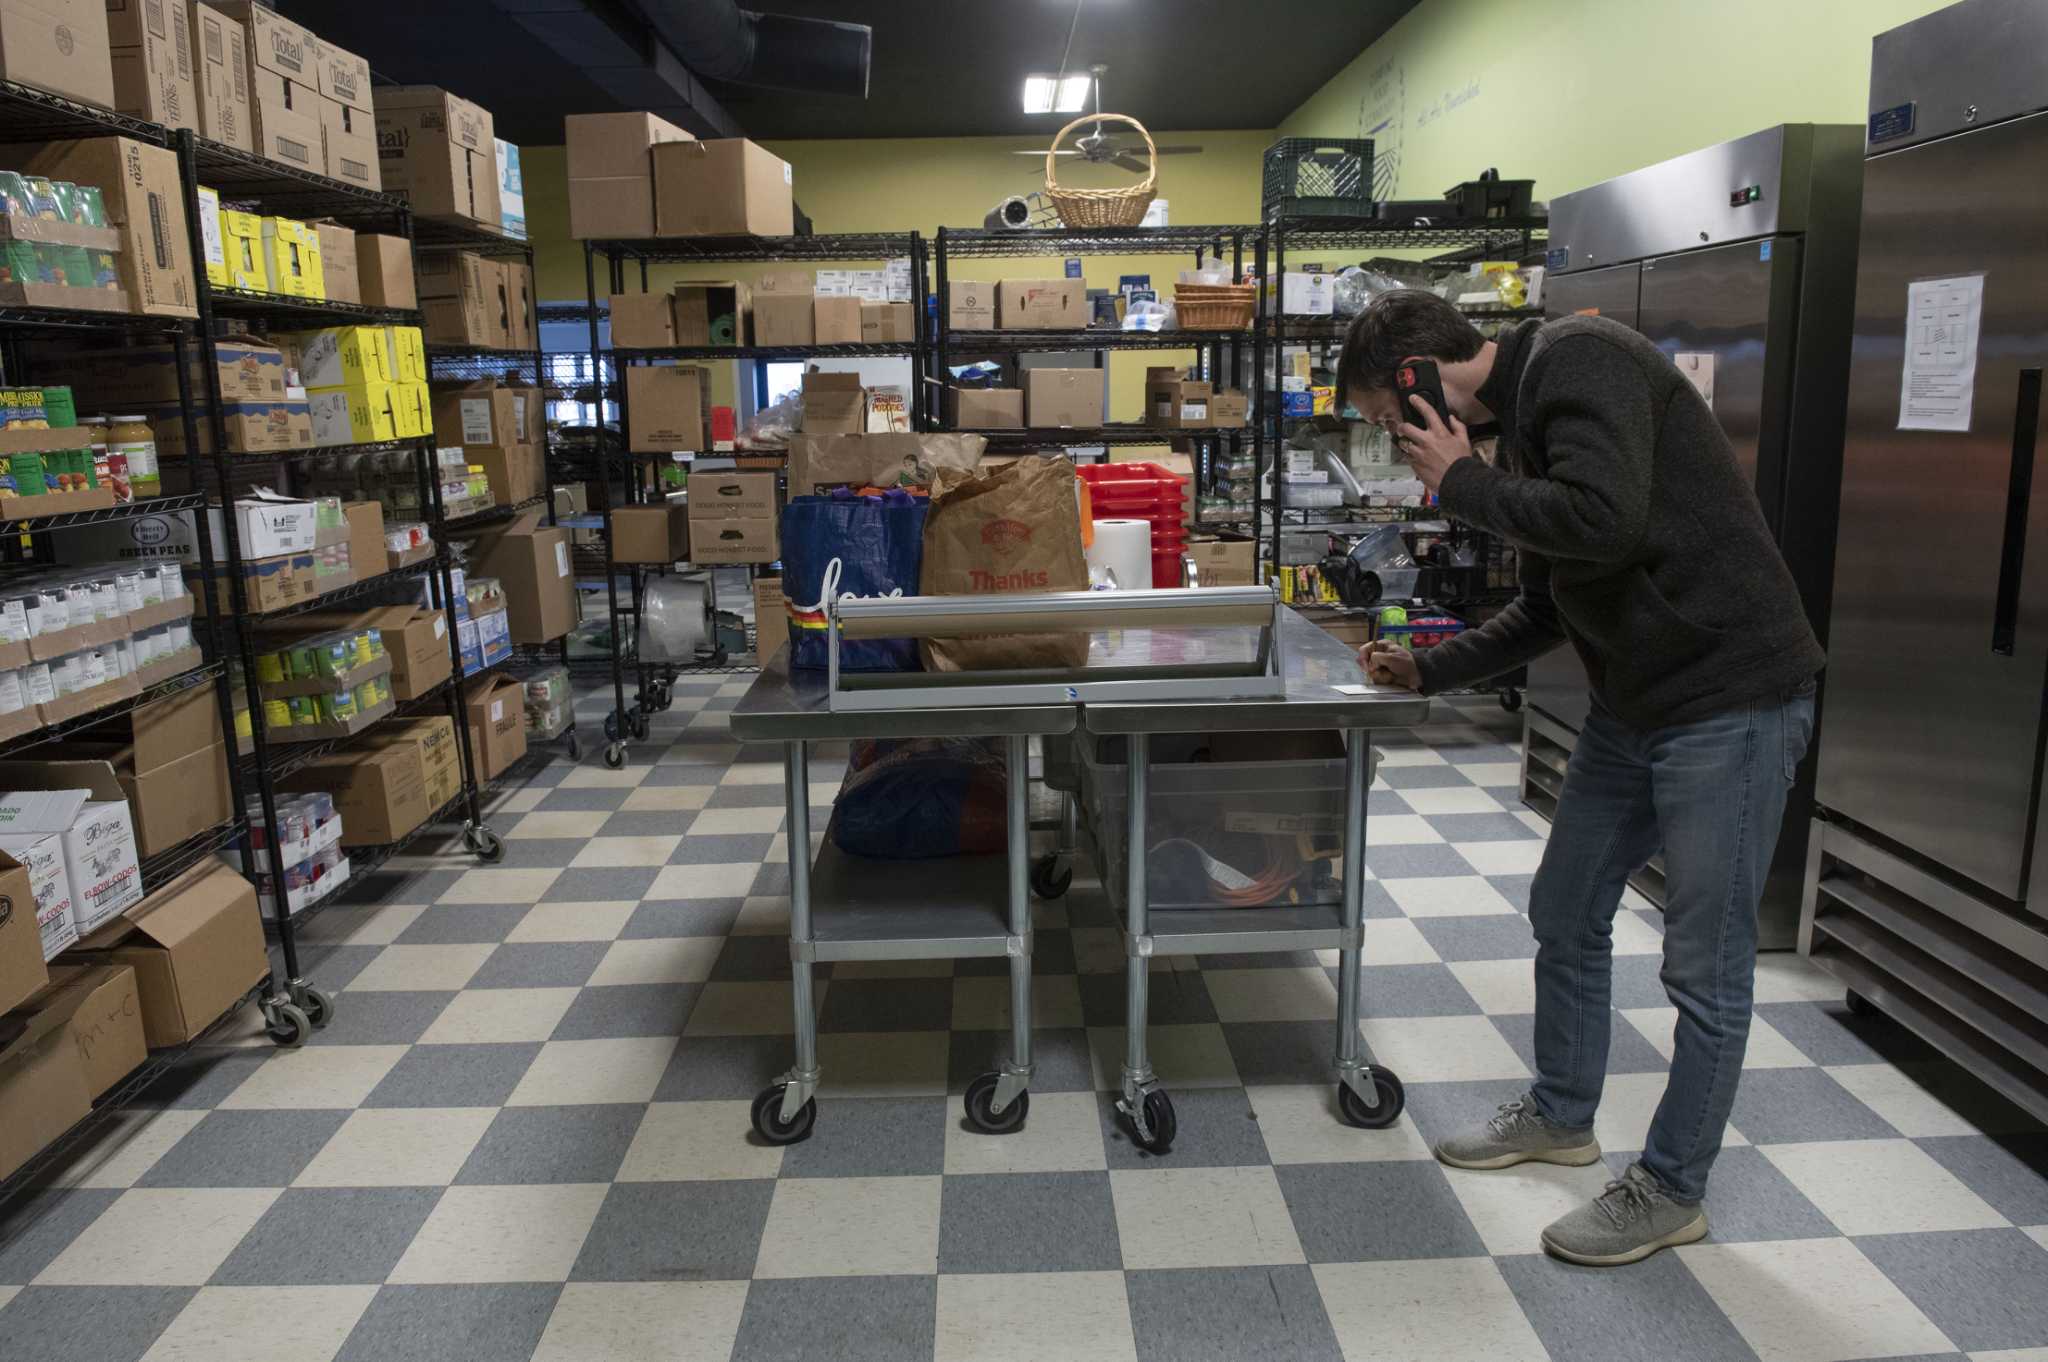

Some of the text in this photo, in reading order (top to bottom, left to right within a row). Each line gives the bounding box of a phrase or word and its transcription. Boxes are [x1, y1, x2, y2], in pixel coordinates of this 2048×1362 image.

[131, 146, 143, 189] 10215
[120, 544, 191, 557] GREEN PEAS
[968, 568, 1048, 592] Thanks
